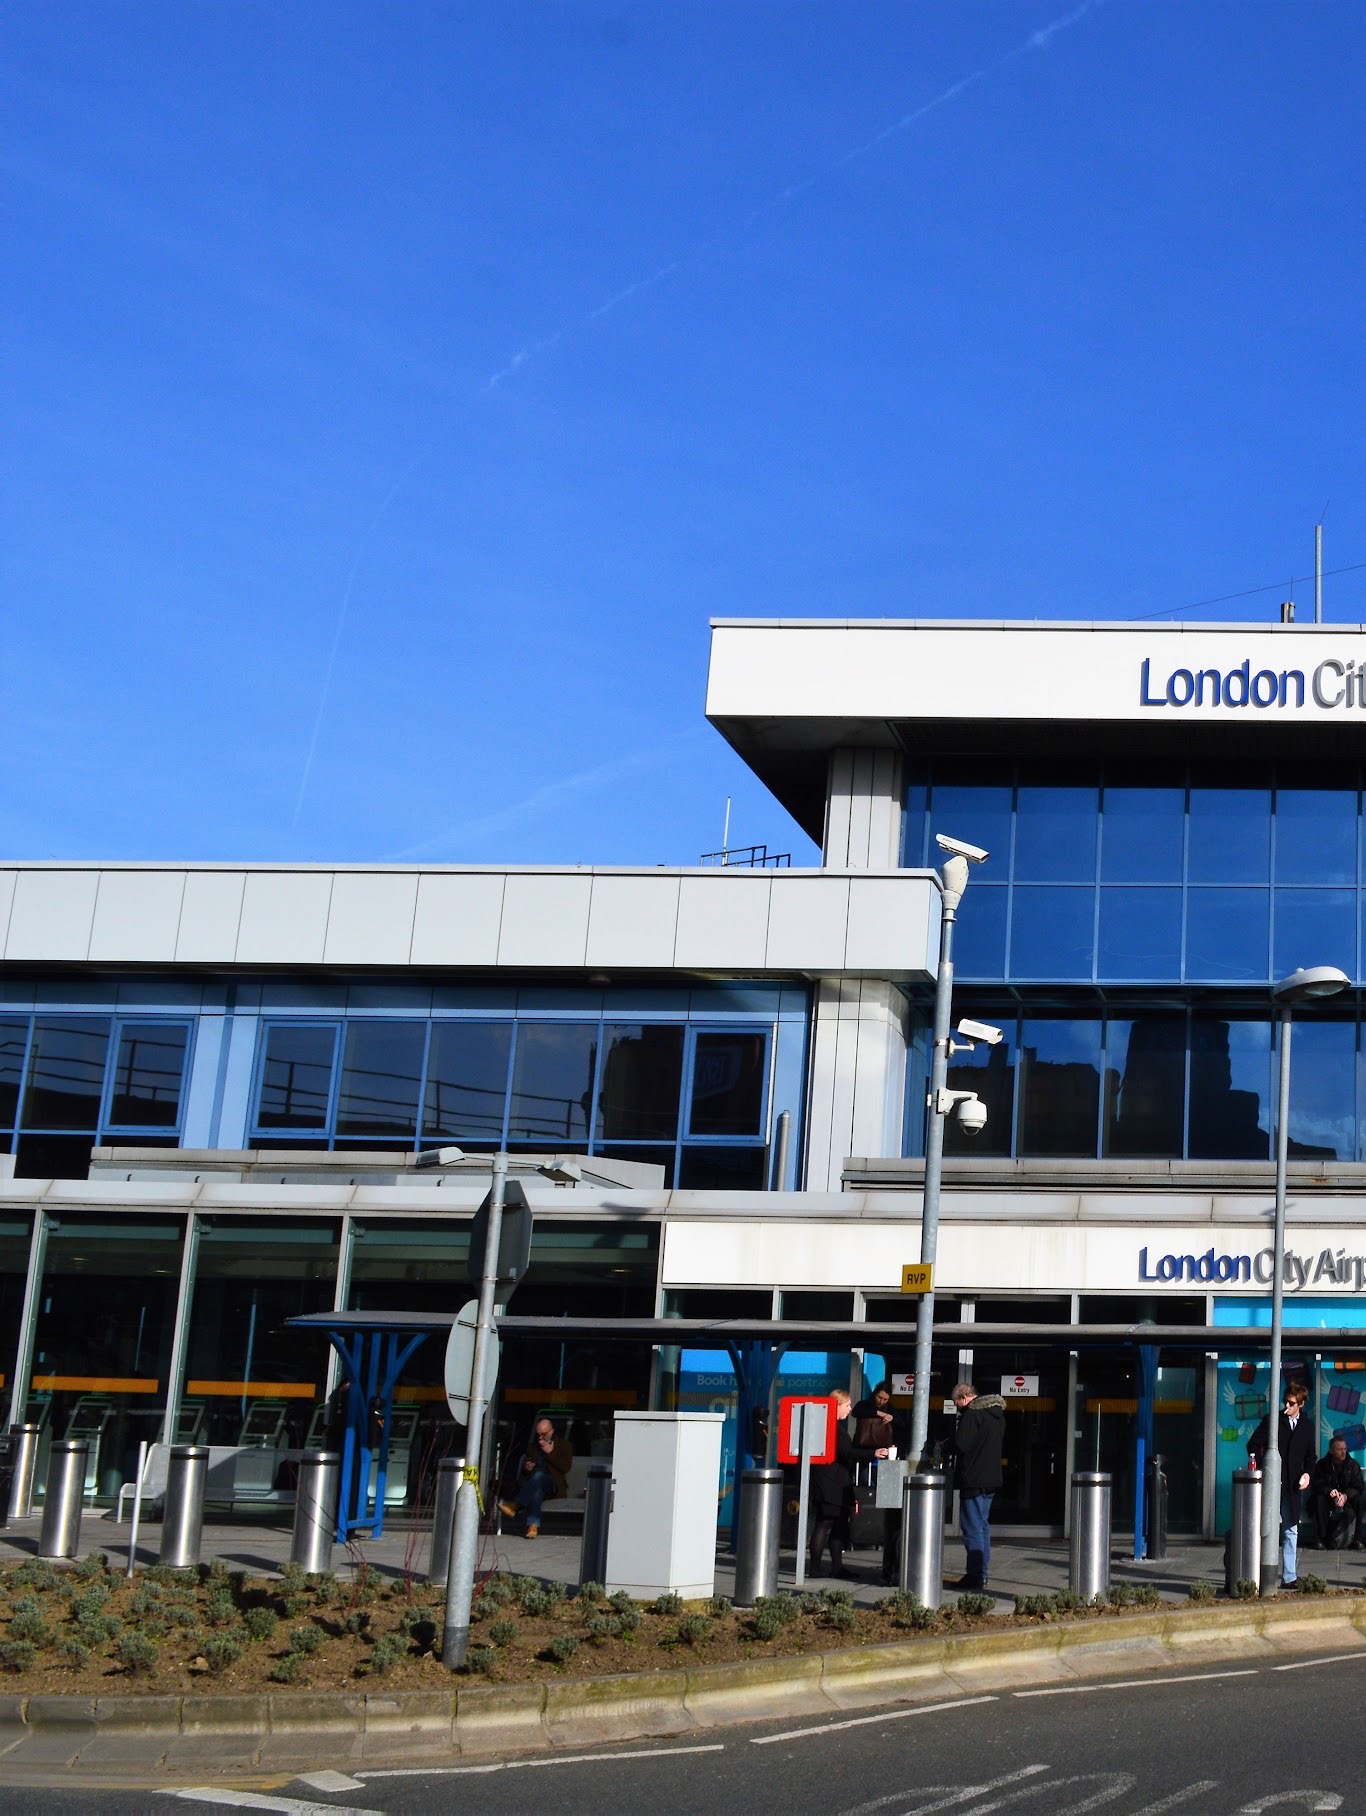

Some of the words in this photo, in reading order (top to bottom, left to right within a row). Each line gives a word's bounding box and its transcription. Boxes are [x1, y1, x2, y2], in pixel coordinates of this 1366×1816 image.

[1141, 658, 1305, 707] London
[907, 1273, 926, 1285] RVP
[1138, 1247, 1251, 1283] London
[1253, 1247, 1314, 1293] Cty
[696, 1374, 727, 1386] Book
